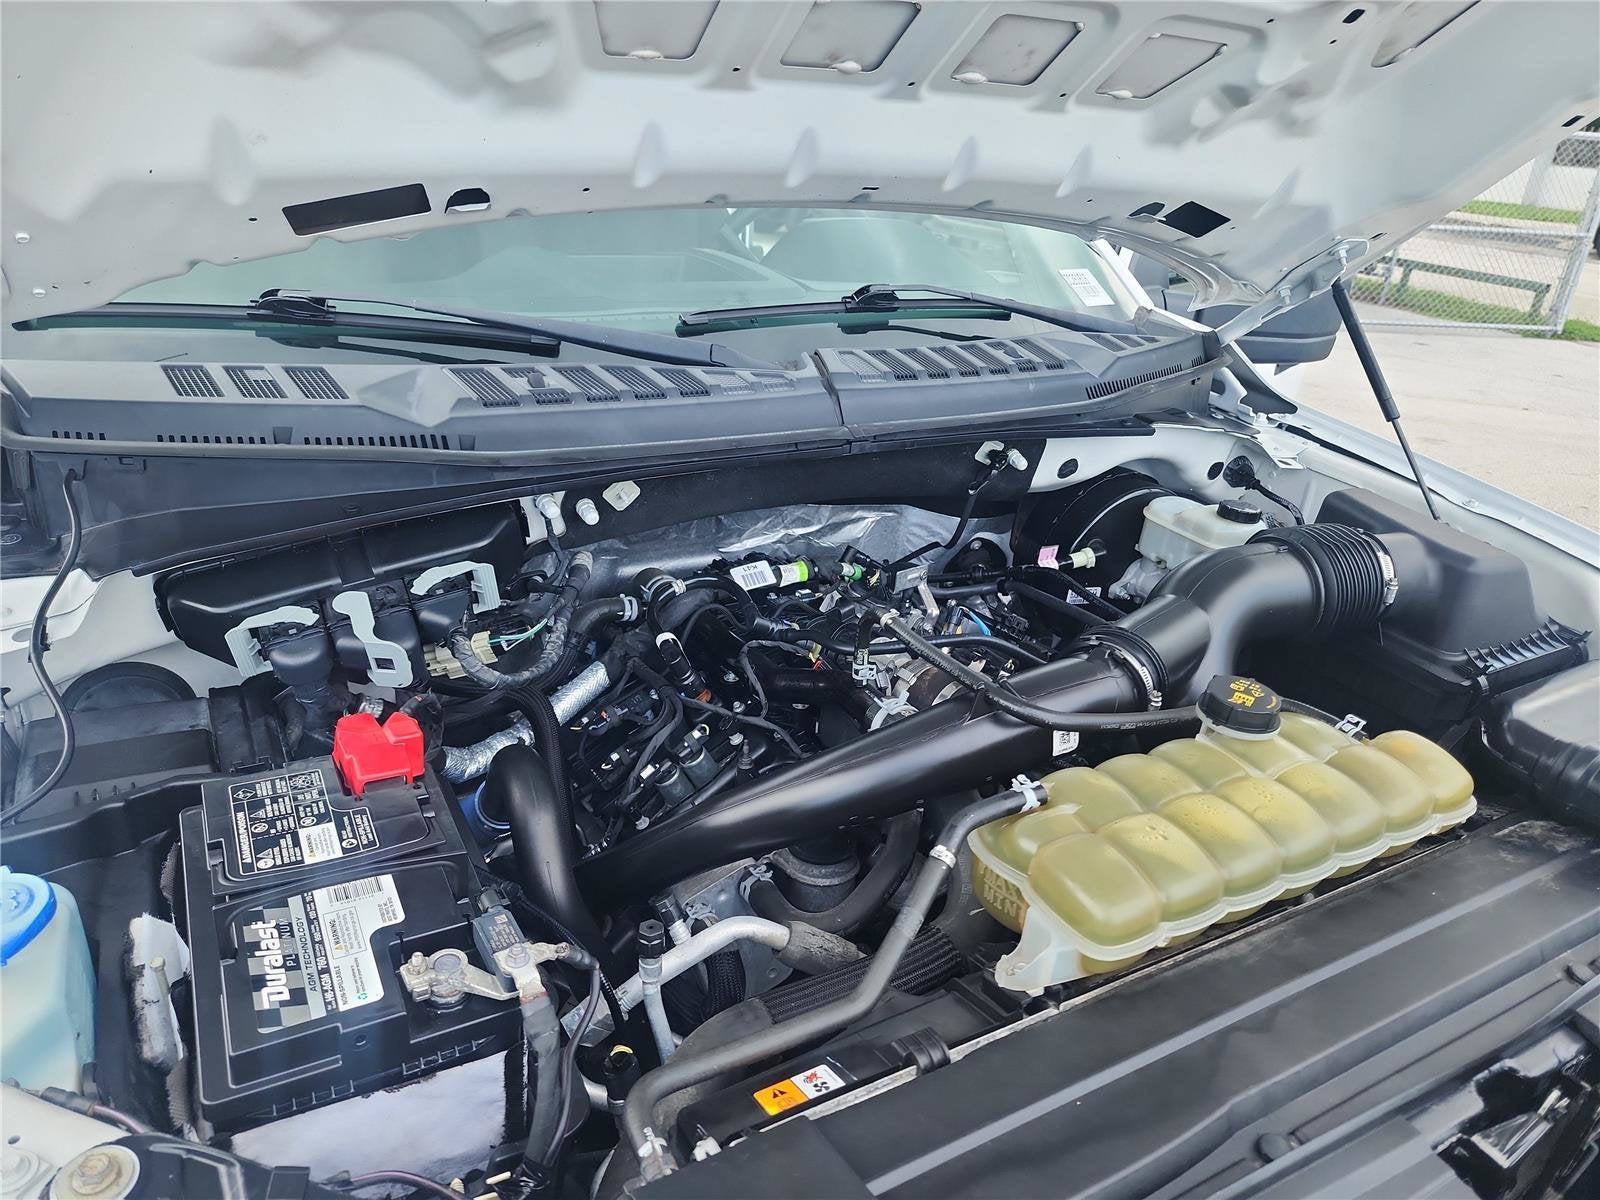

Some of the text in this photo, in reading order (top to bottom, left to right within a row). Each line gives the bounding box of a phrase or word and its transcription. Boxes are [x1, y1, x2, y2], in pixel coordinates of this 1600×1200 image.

[984, 884, 1017, 917] MIN
[278, 916, 296, 966] PLATINUM
[329, 918, 340, 945] WARNING:
[250, 918, 290, 1008] Duralast
[295, 916, 317, 991] AGM TECHNOLOGY
[319, 972, 335, 1001] H6-AGM
[333, 965, 348, 1004] NON-SPILLABLE
